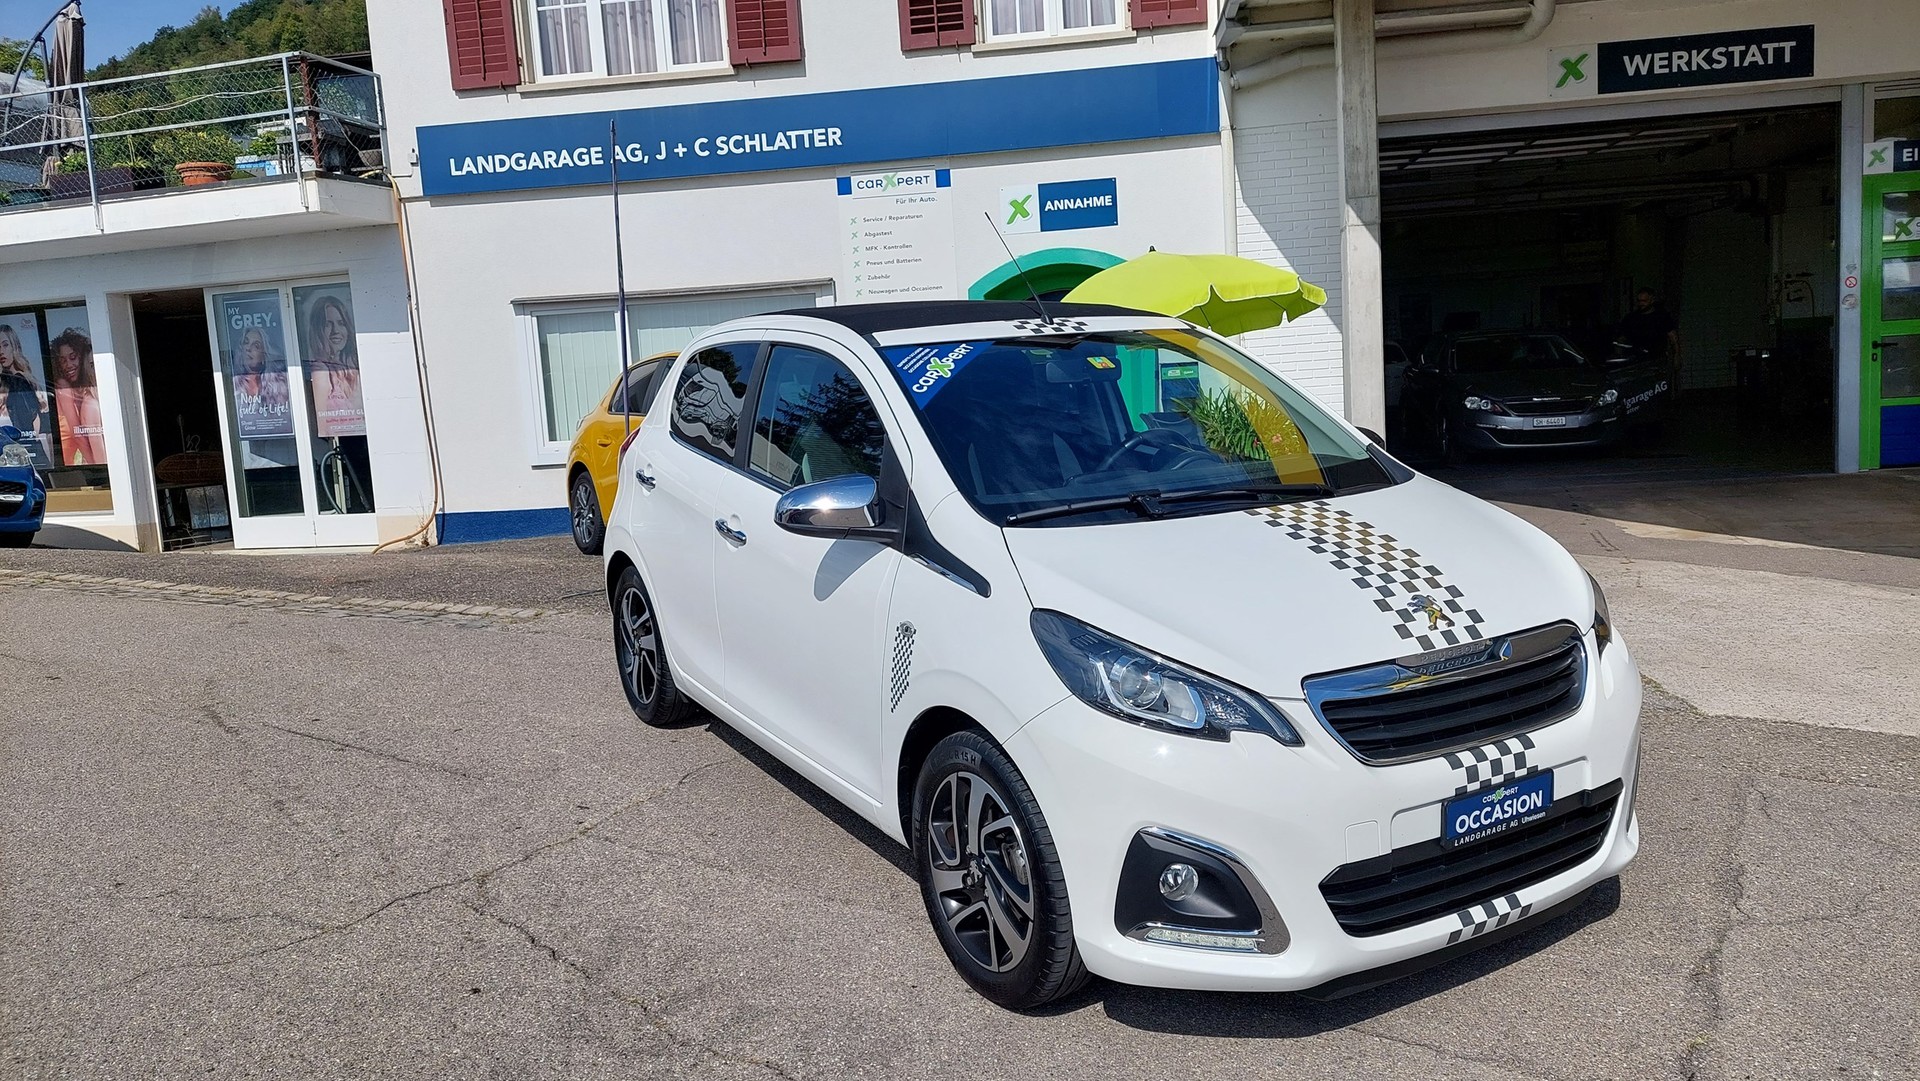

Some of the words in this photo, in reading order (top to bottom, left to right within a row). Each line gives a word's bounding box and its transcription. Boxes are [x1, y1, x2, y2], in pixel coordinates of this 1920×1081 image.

[1623, 41, 1797, 76] WERKSTATT
[450, 146, 604, 176] LANDGARAGE
[610, 143, 649, 164] AG,
[654, 141, 667, 160] J
[694, 137, 711, 157] C
[715, 127, 842, 155] SCHLATTER
[1044, 194, 1113, 212] ANNAHME
[228, 306, 240, 315] MY
[231, 312, 277, 330] GREY.
[1654, 380, 1668, 395] AG
[240, 403, 257, 418] full
[259, 403, 268, 417] of
[269, 400, 289, 416] Life!
[1455, 790, 1543, 834] OCCASION
[1454, 823, 1507, 847] LANDGARAGE
[1509, 819, 1519, 828] AG
